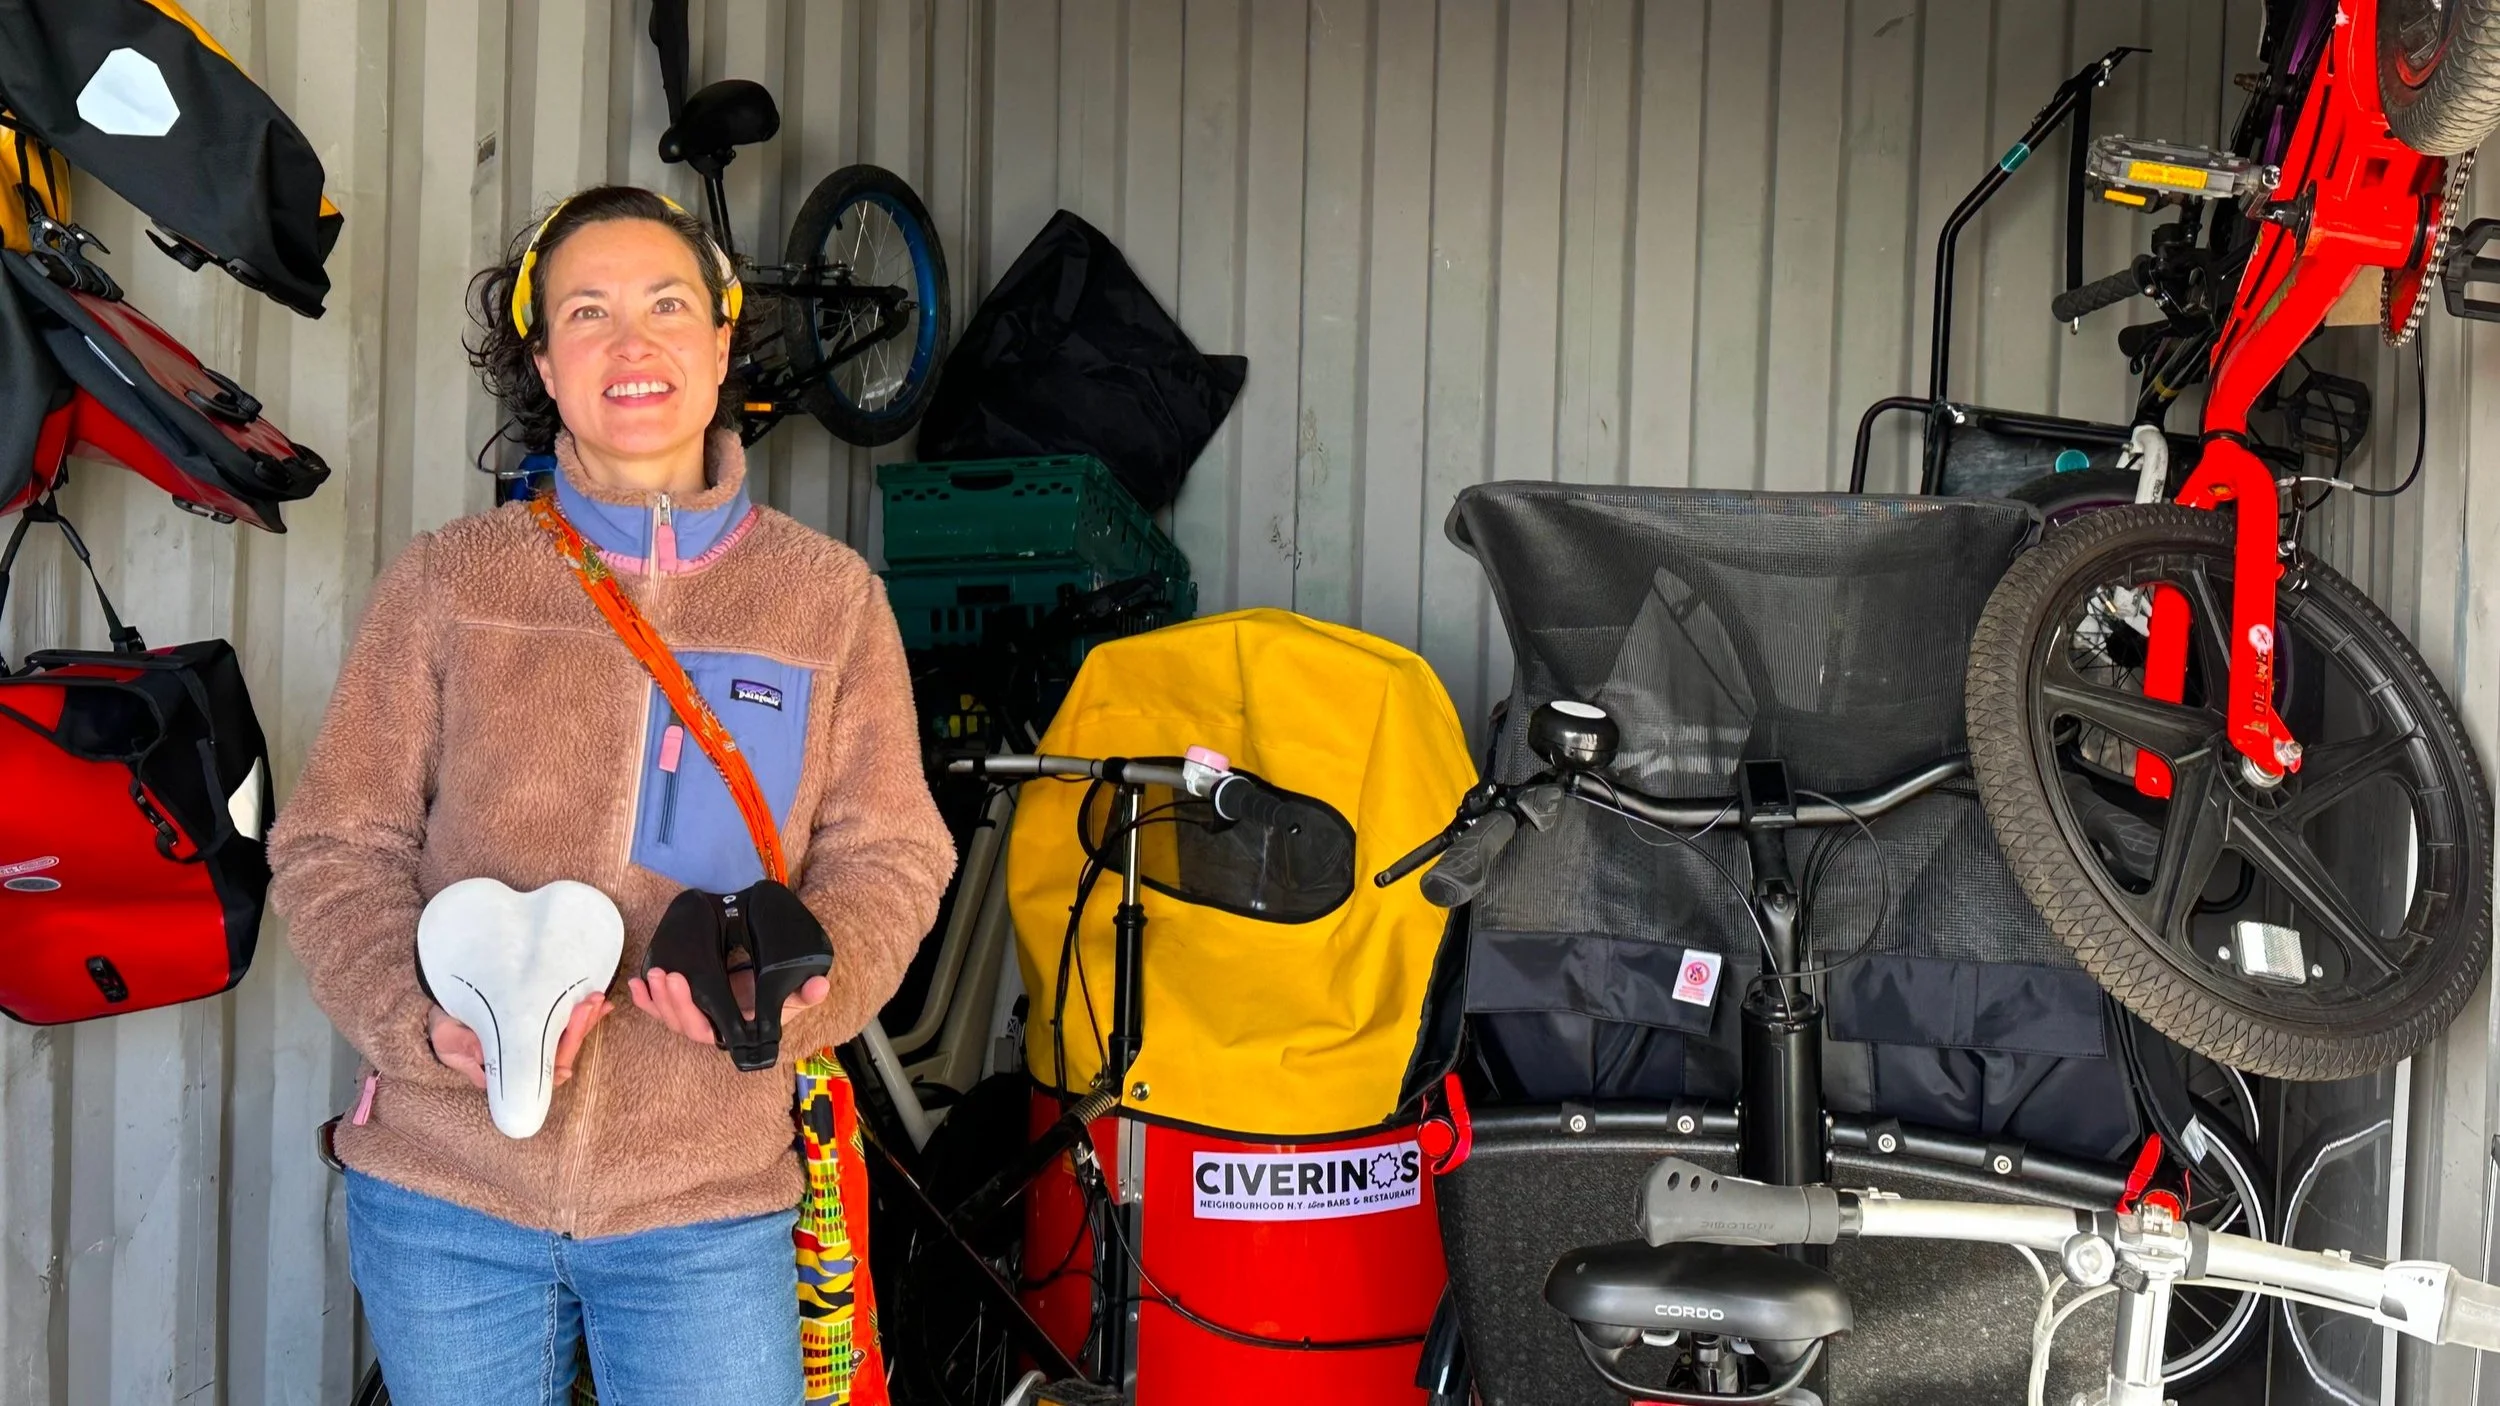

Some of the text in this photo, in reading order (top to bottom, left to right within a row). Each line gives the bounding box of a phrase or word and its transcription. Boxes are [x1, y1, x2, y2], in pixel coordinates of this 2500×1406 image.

[1200, 1200, 1284, 1210] NEIGHBOURHOOD
[1327, 1198, 1350, 1208] BARS
[1363, 1188, 1416, 1204] RESTAURANT
[1655, 1304, 1724, 1320] CORDO
